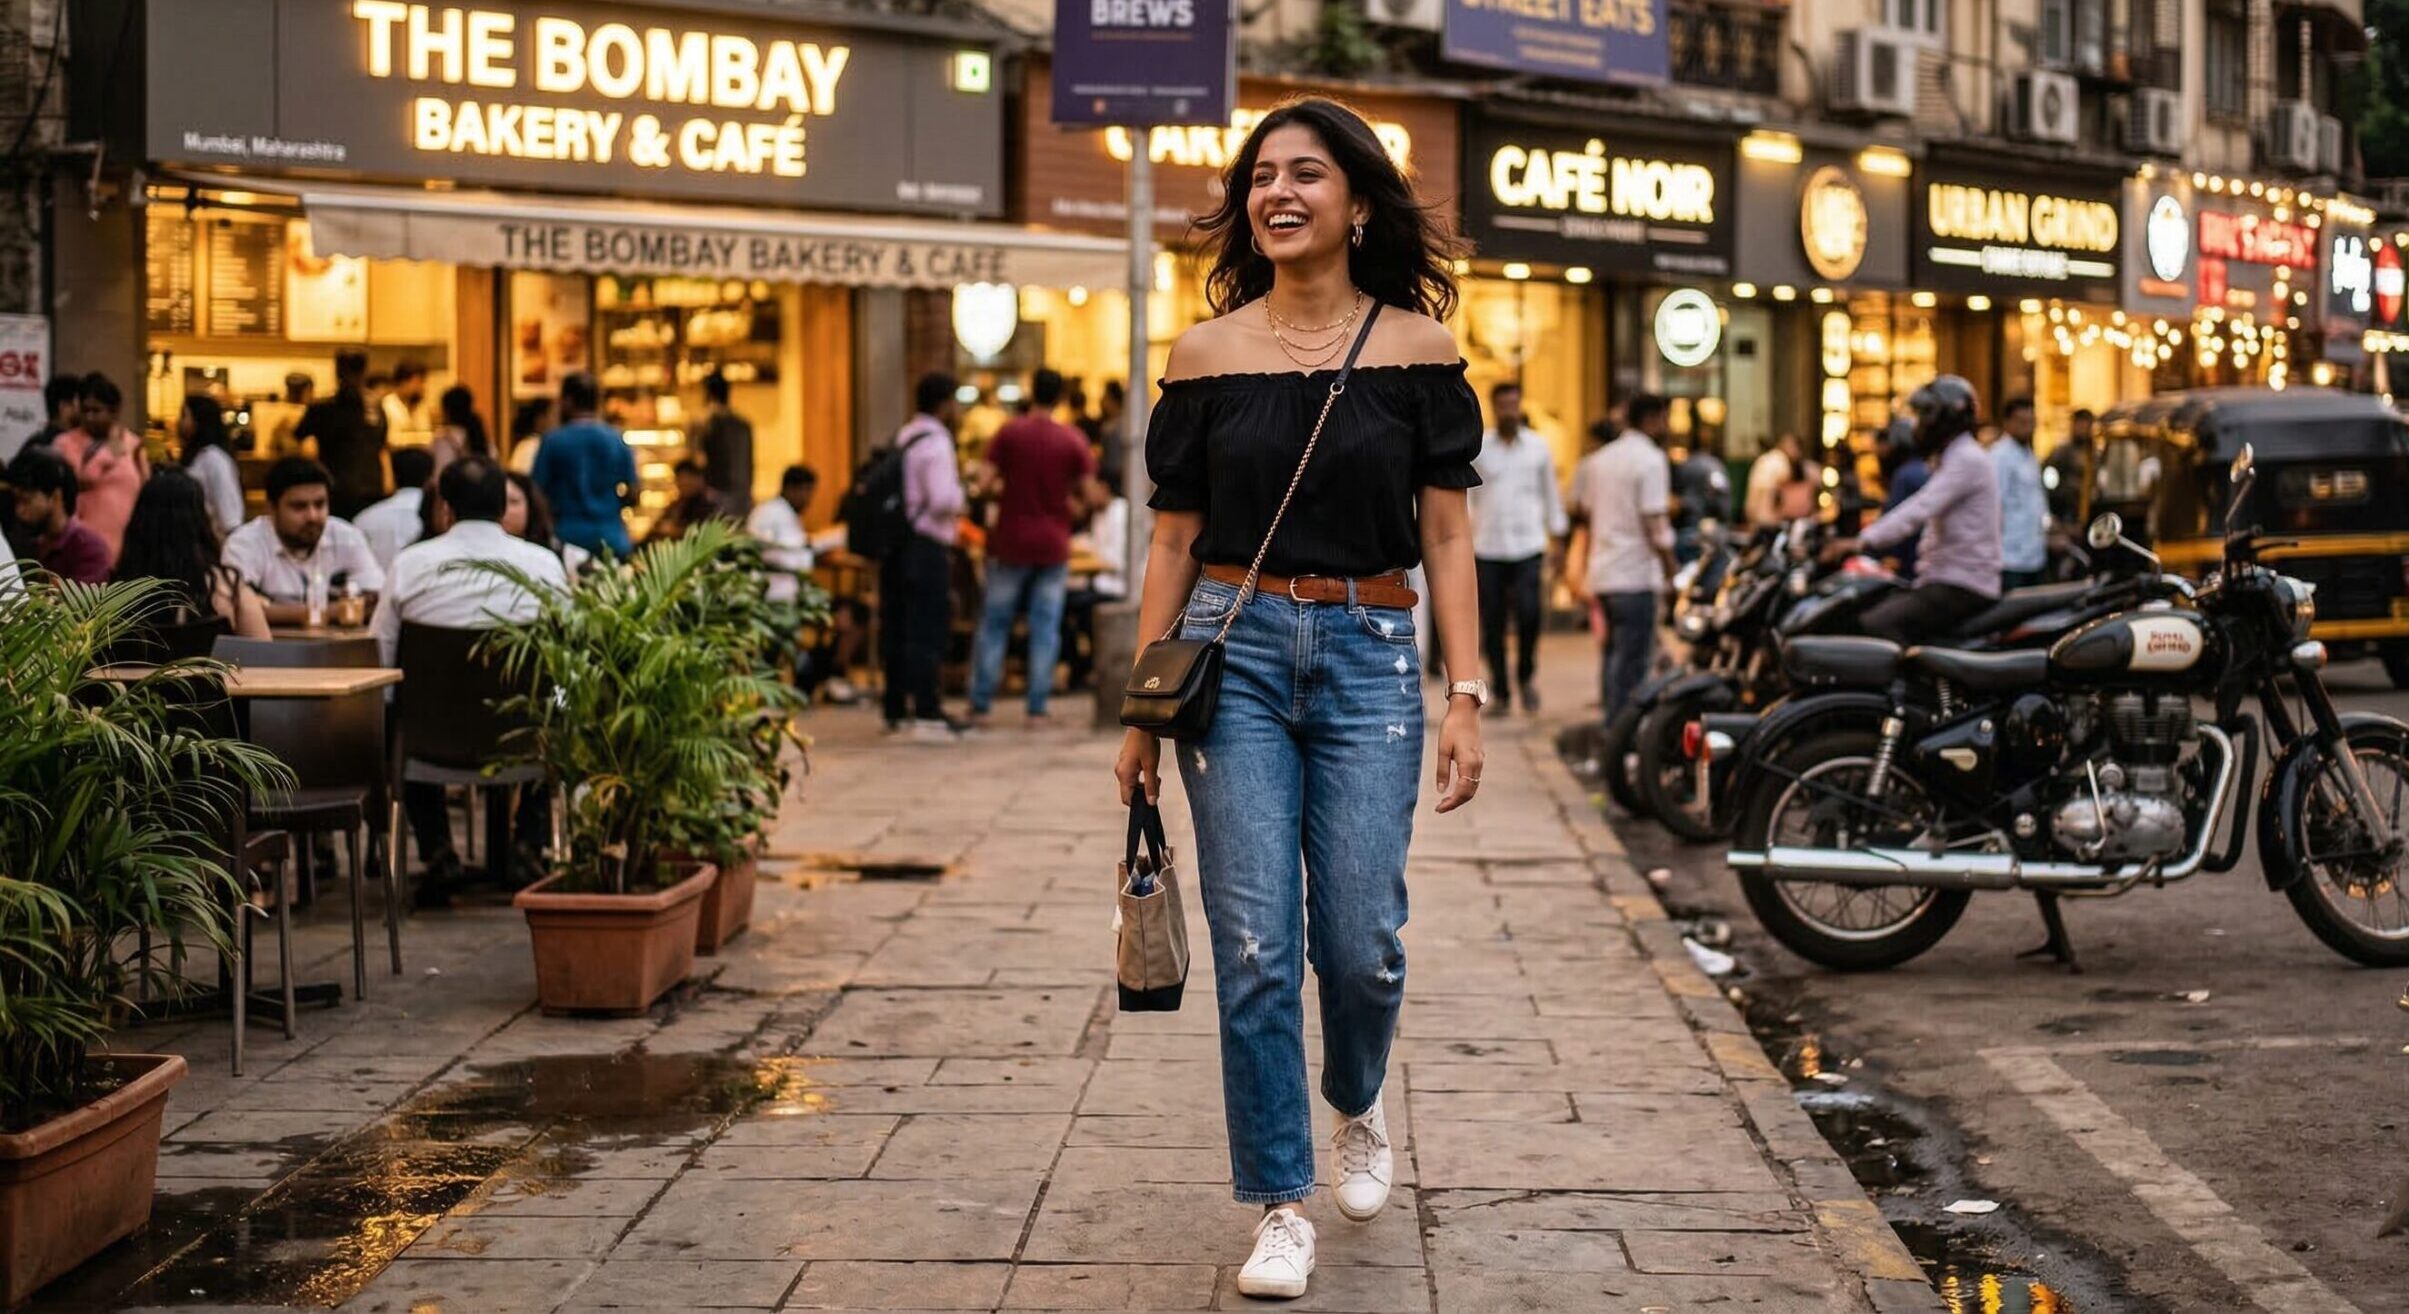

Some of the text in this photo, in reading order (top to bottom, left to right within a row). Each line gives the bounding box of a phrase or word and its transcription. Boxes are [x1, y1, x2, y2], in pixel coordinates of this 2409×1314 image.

[1091, 0, 1194, 26] BREWS
[1461, 0, 1571, 22] EET
[353, 0, 849, 115] THE BOMBAY
[414, 97, 807, 176] BAKERY & CAFÉ
[1490, 138, 1607, 213] CAFÉ
[1612, 157, 1714, 223] NOIR
[500, 224, 571, 260] THE
[584, 230, 738, 270] BOMBAY
[749, 237, 886, 276] BAKERY
[898, 246, 914, 277] &
